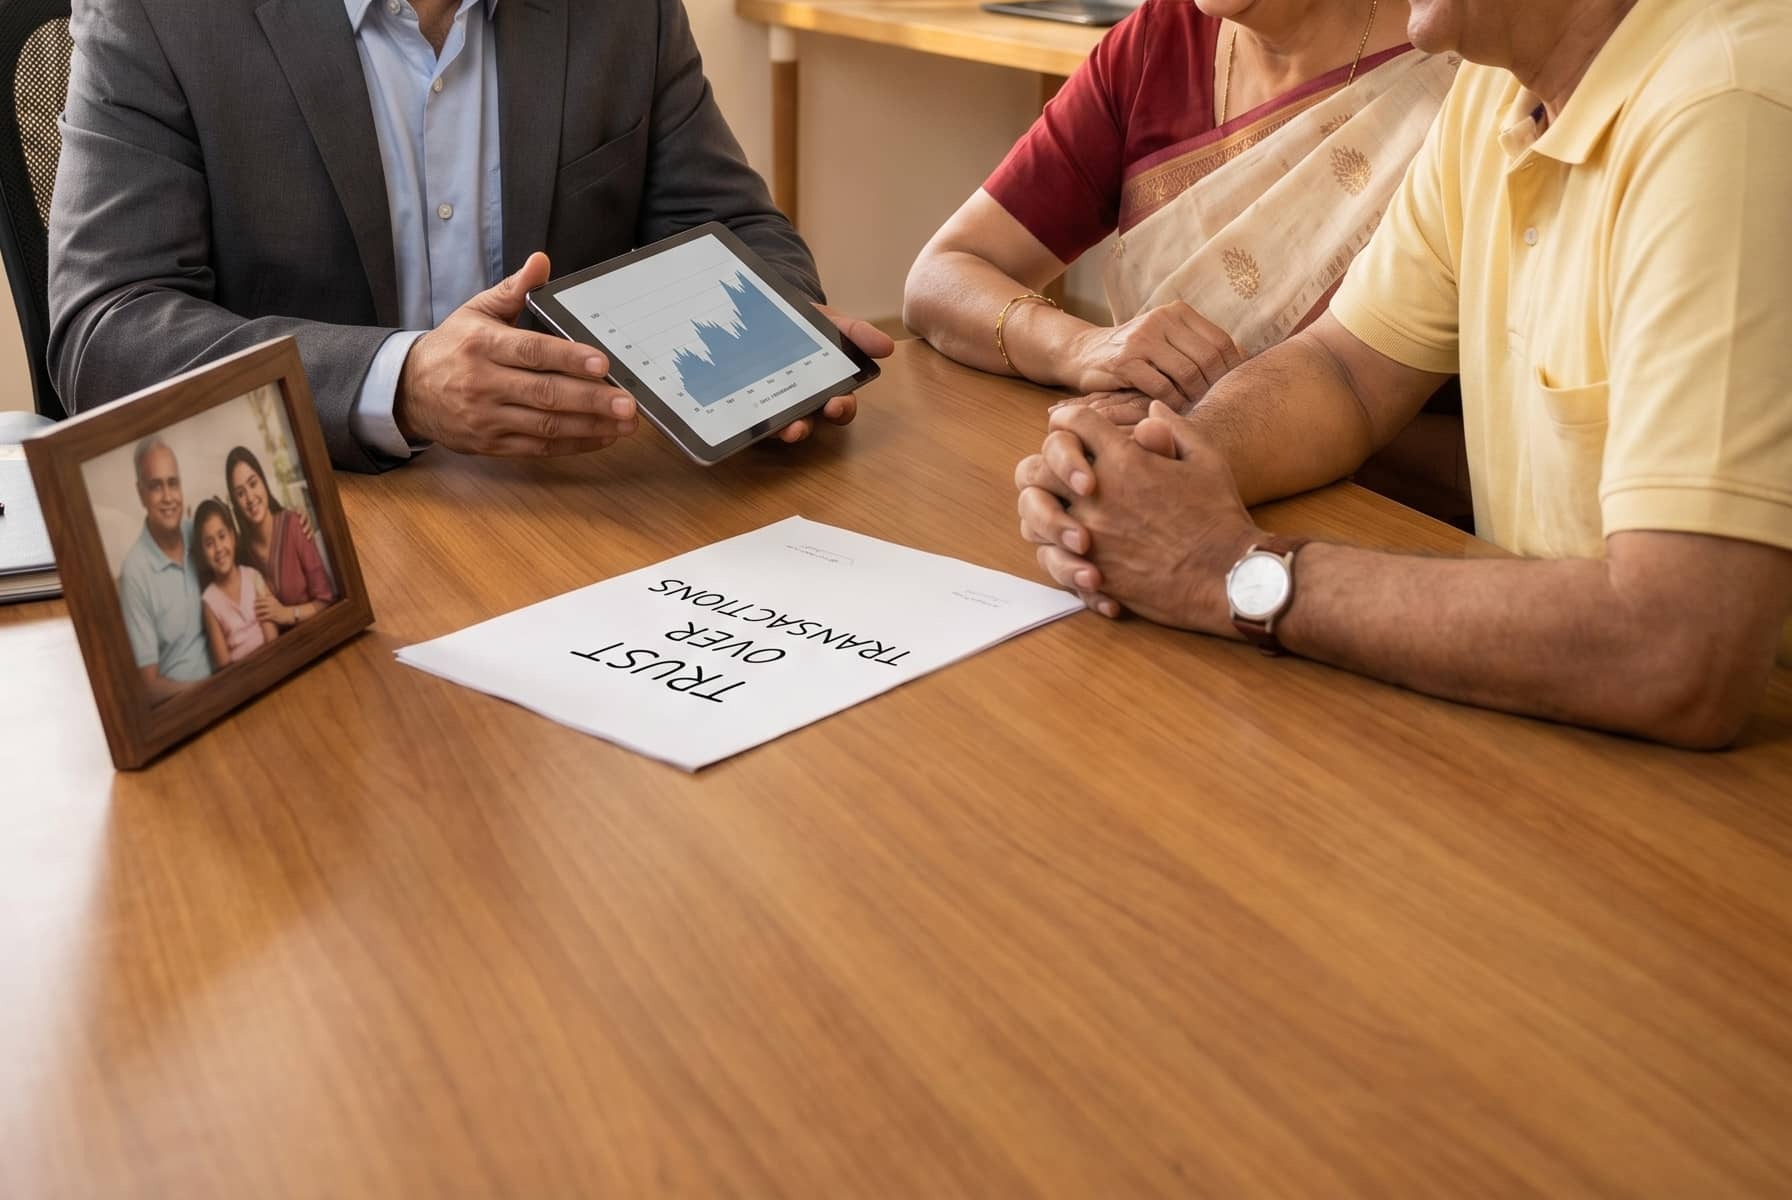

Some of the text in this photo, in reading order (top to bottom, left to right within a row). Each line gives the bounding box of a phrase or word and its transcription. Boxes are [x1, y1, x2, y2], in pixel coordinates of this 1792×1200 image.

[647, 579, 911, 667] TRANSACTIONS
[664, 621, 787, 664] OVER
[569, 642, 746, 703] TRUST
